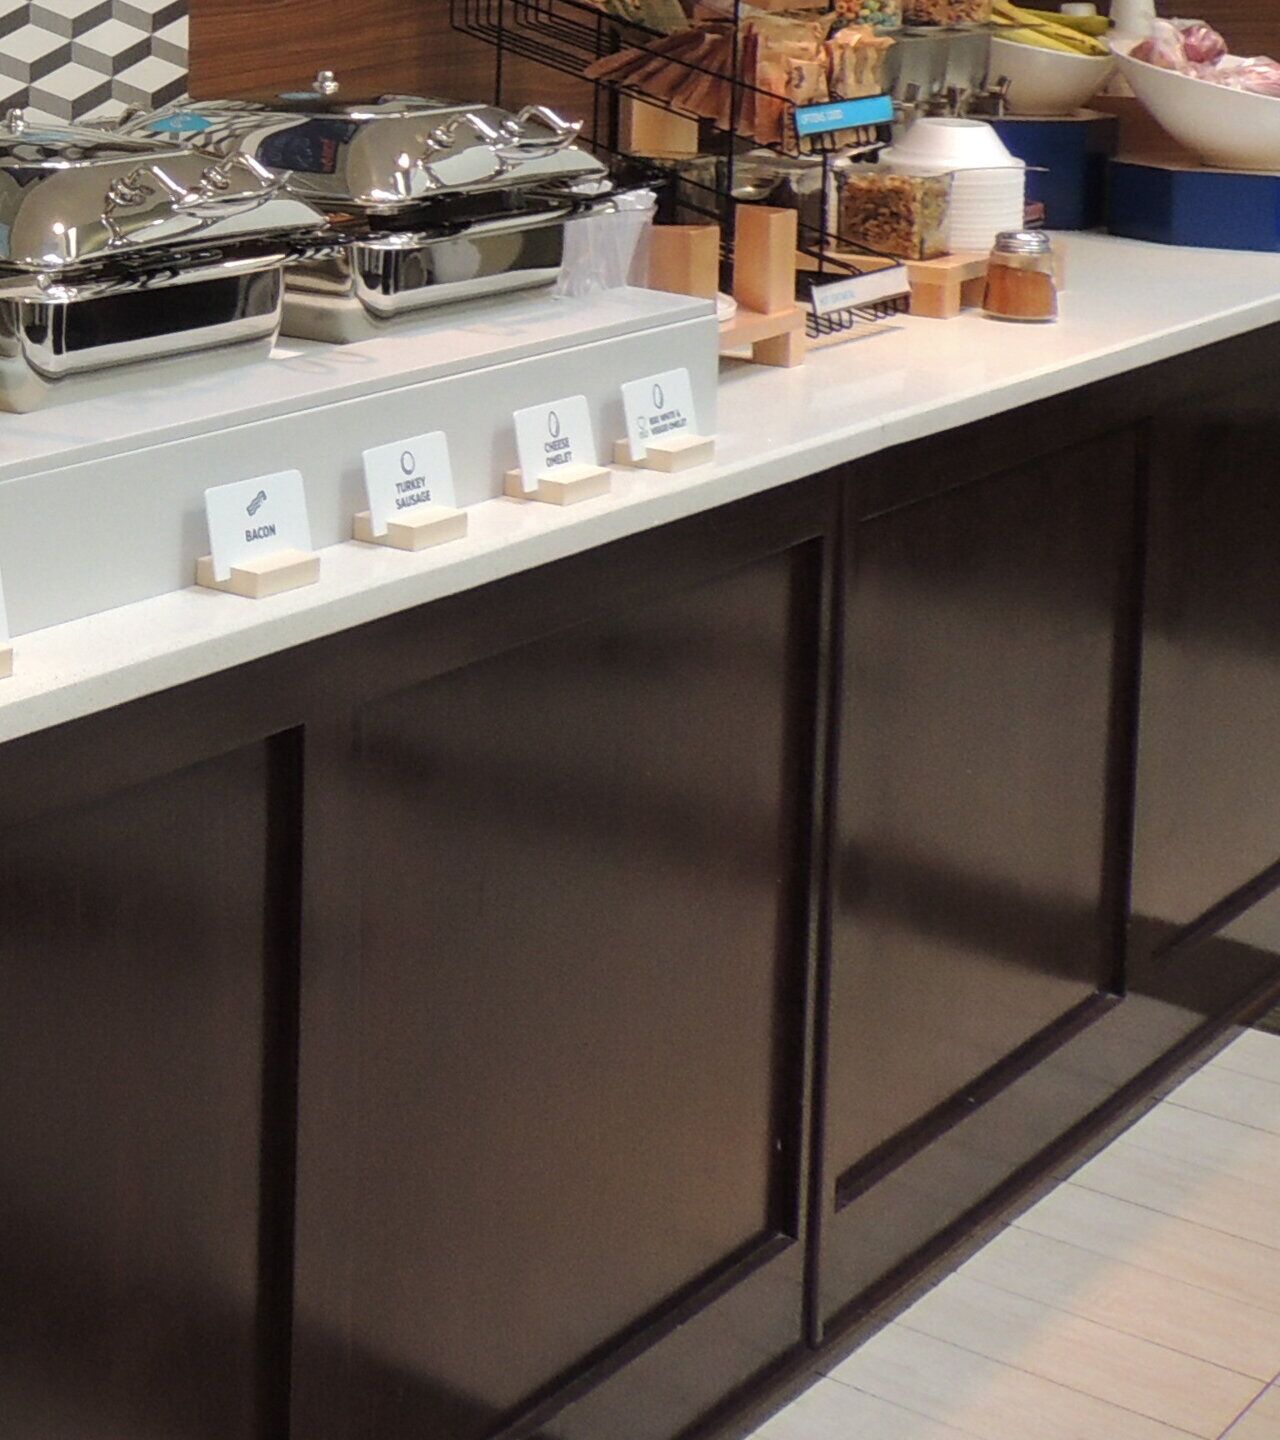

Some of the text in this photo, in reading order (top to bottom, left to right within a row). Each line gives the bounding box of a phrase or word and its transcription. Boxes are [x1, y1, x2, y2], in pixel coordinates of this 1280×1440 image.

[544, 437, 570, 453] CHEESE
[546, 451, 572, 467] OMELET
[395, 476, 426, 494] TURKEY
[395, 490, 431, 510] SAUSAGE
[245, 524, 276, 542] BACON
